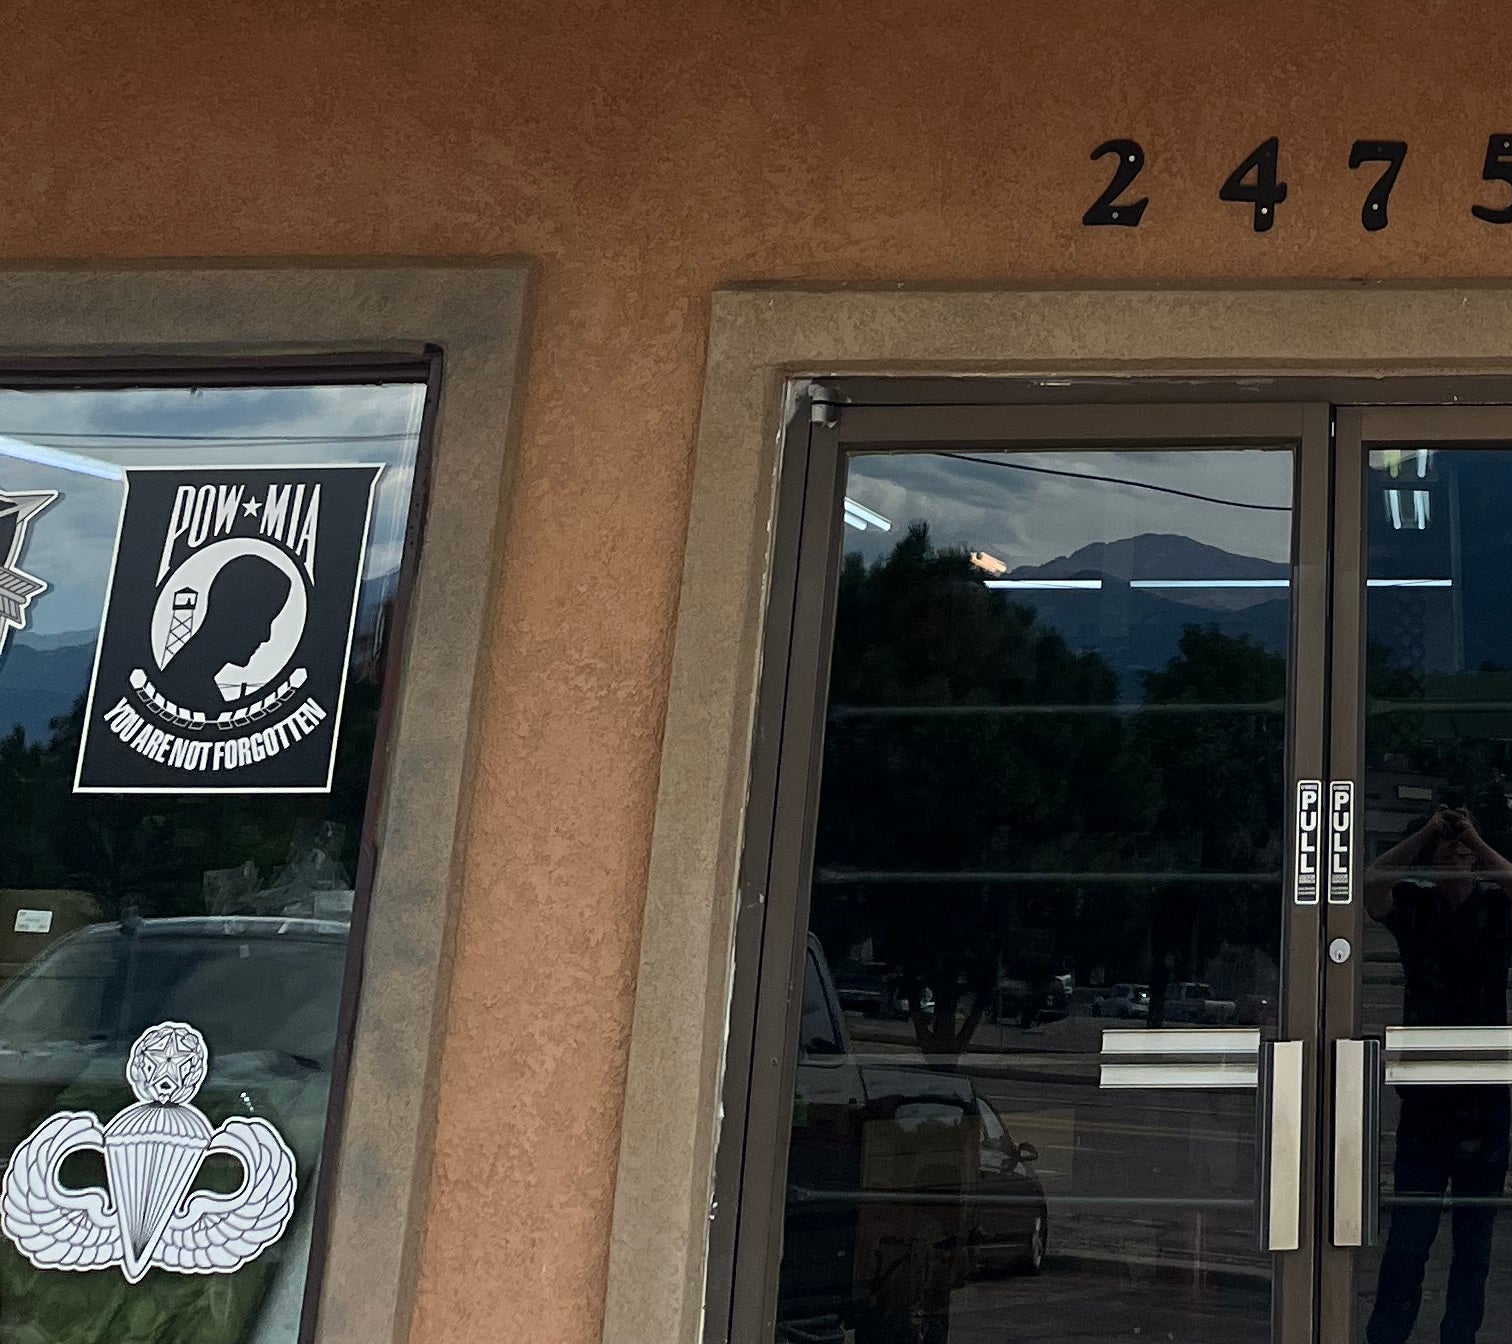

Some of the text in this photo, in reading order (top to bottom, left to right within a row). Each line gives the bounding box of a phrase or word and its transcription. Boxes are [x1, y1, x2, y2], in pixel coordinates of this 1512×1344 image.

[155, 483, 323, 588] POW MIA
[103, 696, 328, 771] YOU ARE NOT FORGOTTEN
[1300, 790, 1318, 874] PULL
[1333, 790, 1350, 874] PULL
